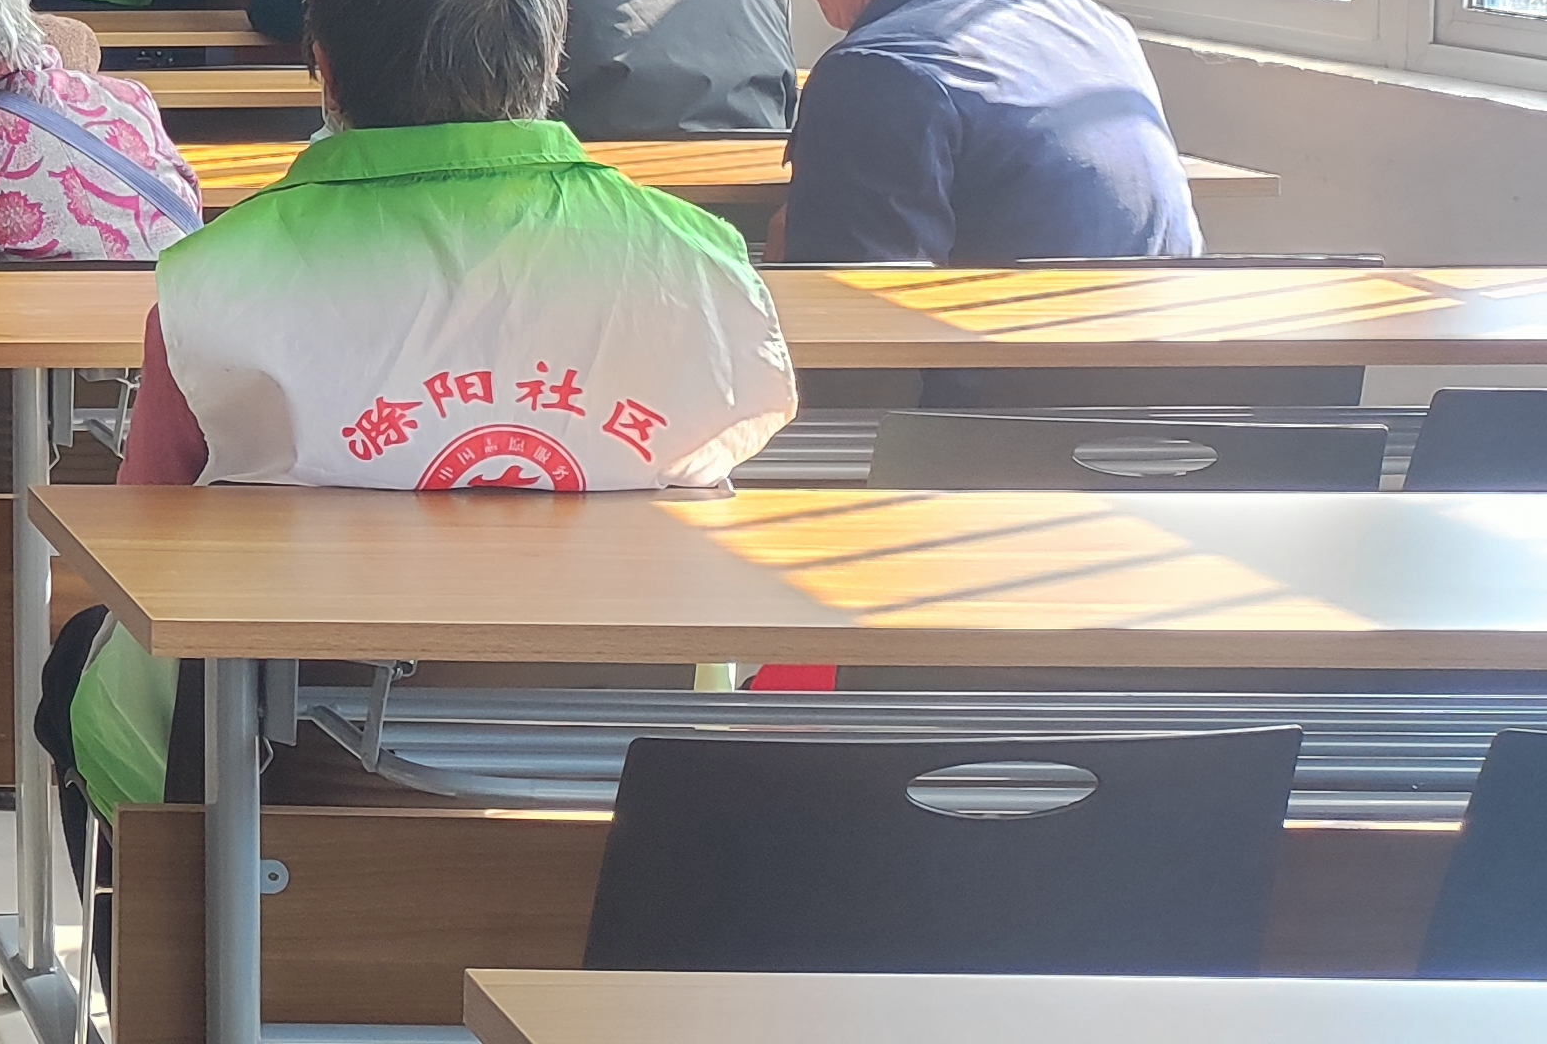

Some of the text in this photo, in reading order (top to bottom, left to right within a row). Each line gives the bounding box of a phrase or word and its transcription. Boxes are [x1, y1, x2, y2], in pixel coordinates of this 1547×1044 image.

[341, 360, 669, 463] 滁阳社区
[438, 435, 570, 482] 中国志愿服务
